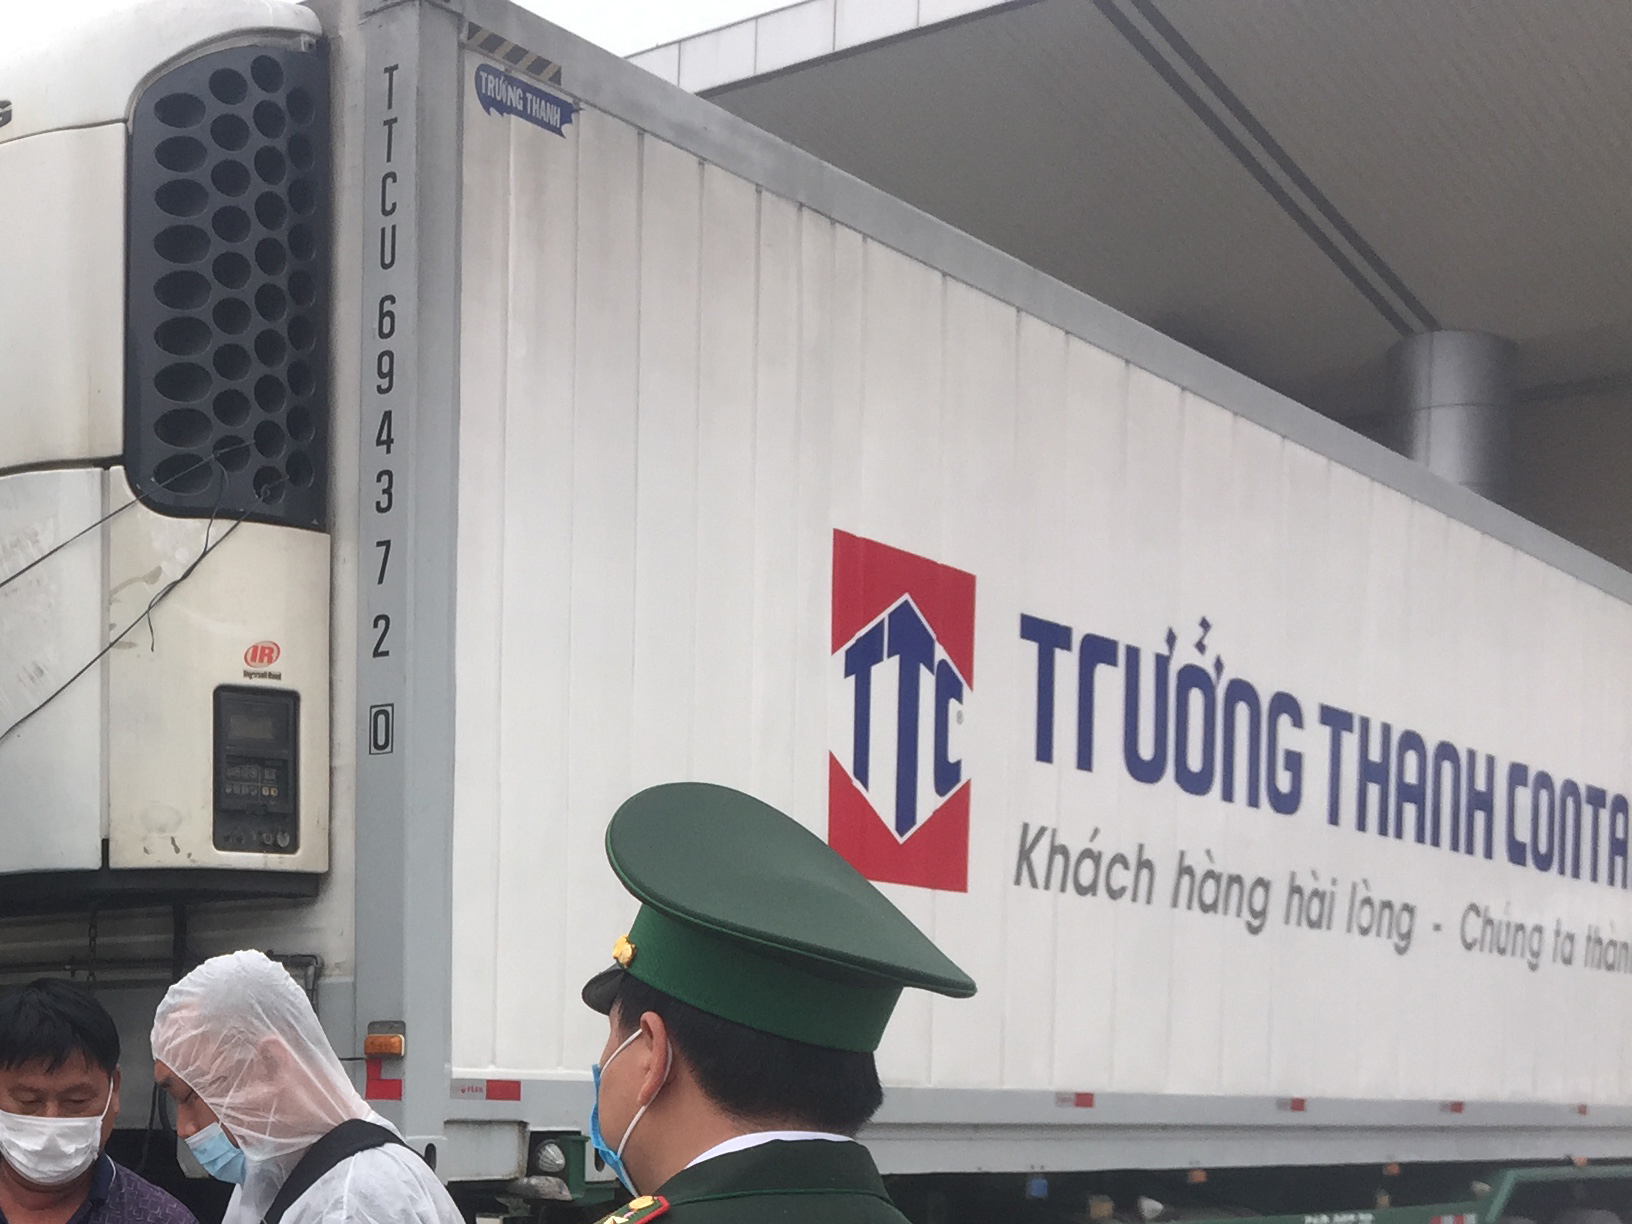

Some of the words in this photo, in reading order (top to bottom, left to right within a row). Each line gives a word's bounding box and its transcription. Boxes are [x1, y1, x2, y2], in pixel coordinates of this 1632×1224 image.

[379, 63, 399, 271] TTCU
[844, 598, 964, 839] TTC
[1319, 702, 1496, 860] THANH
[1014, 821, 1156, 905] Khách
[1170, 848, 1271, 935] hàng
[1284, 869, 1337, 931] hài
[1345, 879, 1417, 955] lòng
